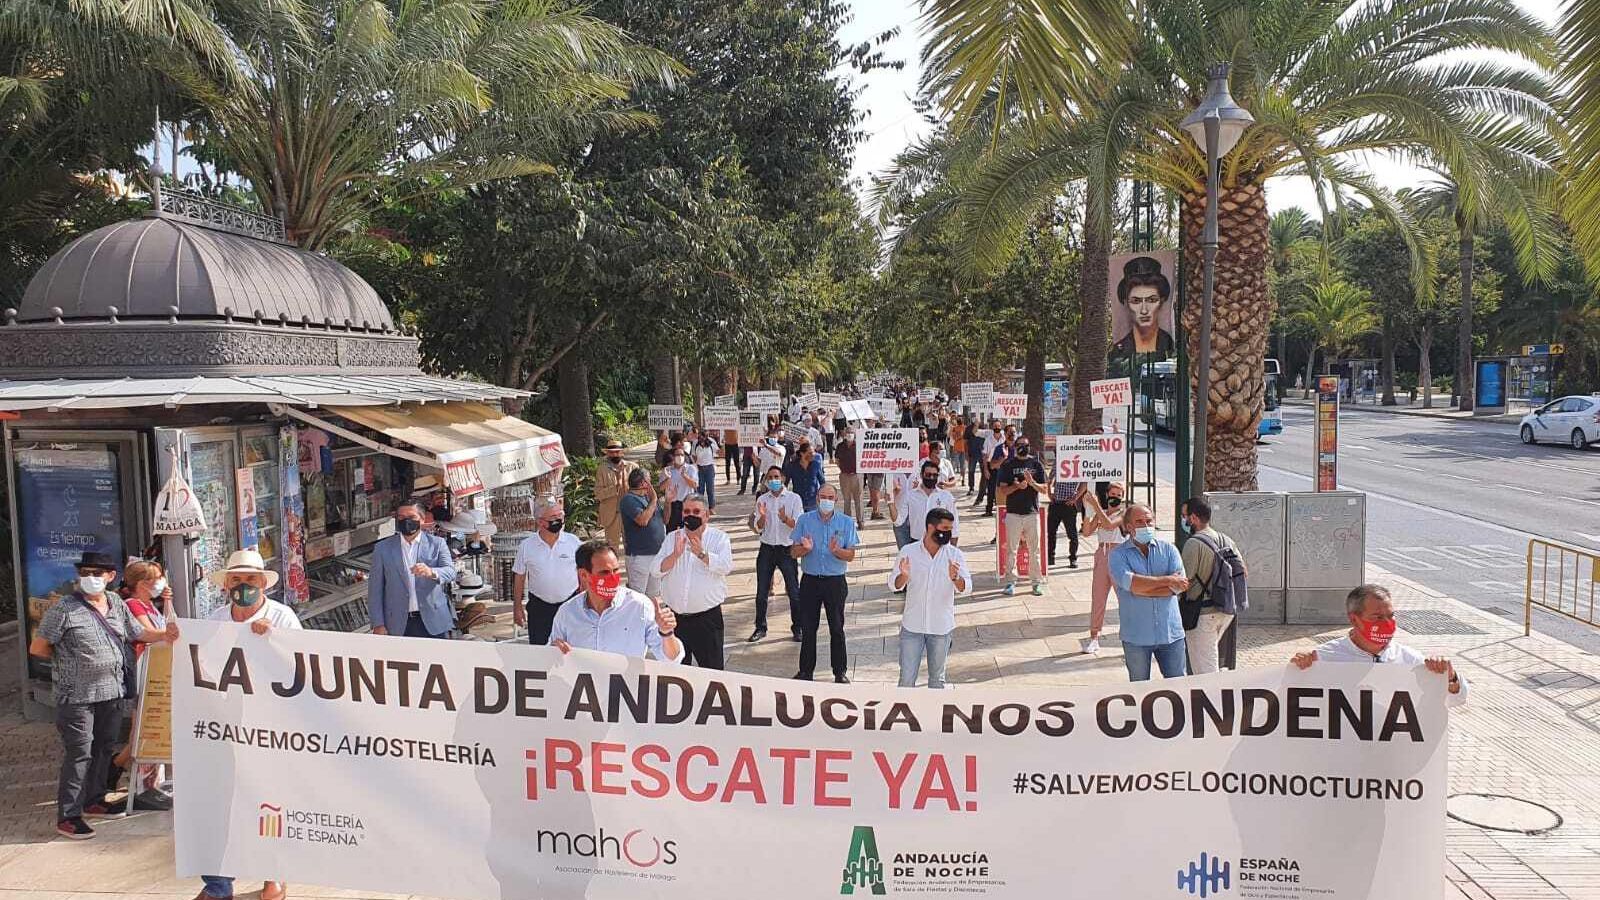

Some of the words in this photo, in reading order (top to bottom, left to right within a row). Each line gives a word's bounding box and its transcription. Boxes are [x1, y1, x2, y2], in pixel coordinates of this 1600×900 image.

[1092, 382, 1129, 395] ¡RESCATE
[1104, 392, 1123, 404] YA!
[1003, 406, 1020, 416] YA!
[864, 430, 879, 441] Sin
[881, 430, 903, 441] ocio
[863, 441, 911, 450] nocturno,
[1099, 438, 1122, 452] NO
[860, 457, 914, 470] contagios
[1060, 455, 1080, 478] SÍ
[1082, 460, 1102, 469] Ocio
[1082, 469, 1122, 480] regulado
[189, 644, 254, 695] LA
[271, 652, 457, 711] JUNTA
[474, 667, 548, 718] DE
[564, 673, 922, 733] ANDALUCÍA
[941, 700, 1075, 737] NOS
[1096, 687, 1425, 742] CONDENA
[193, 720, 496, 767] #SALVEMOSLAHOSTELERÍA
[525, 738, 852, 807] ¡RESCATE
[872, 750, 978, 812] YA!
[1012, 769, 1425, 801] #SALVEMOSELOCIONOCTURNO
[286, 809, 364, 830] HOSTELERÍA
[287, 826, 304, 840] DE
[308, 828, 358, 846] ESPAÑA
[893, 851, 989, 865] ANDALUCÍA
[1240, 858, 1300, 871] ESPAÑA
[893, 867, 915, 877] DE
[925, 867, 989, 878] NOCHE
[1240, 873, 1255, 882] DE
[1259, 873, 1300, 883] NOCHE
